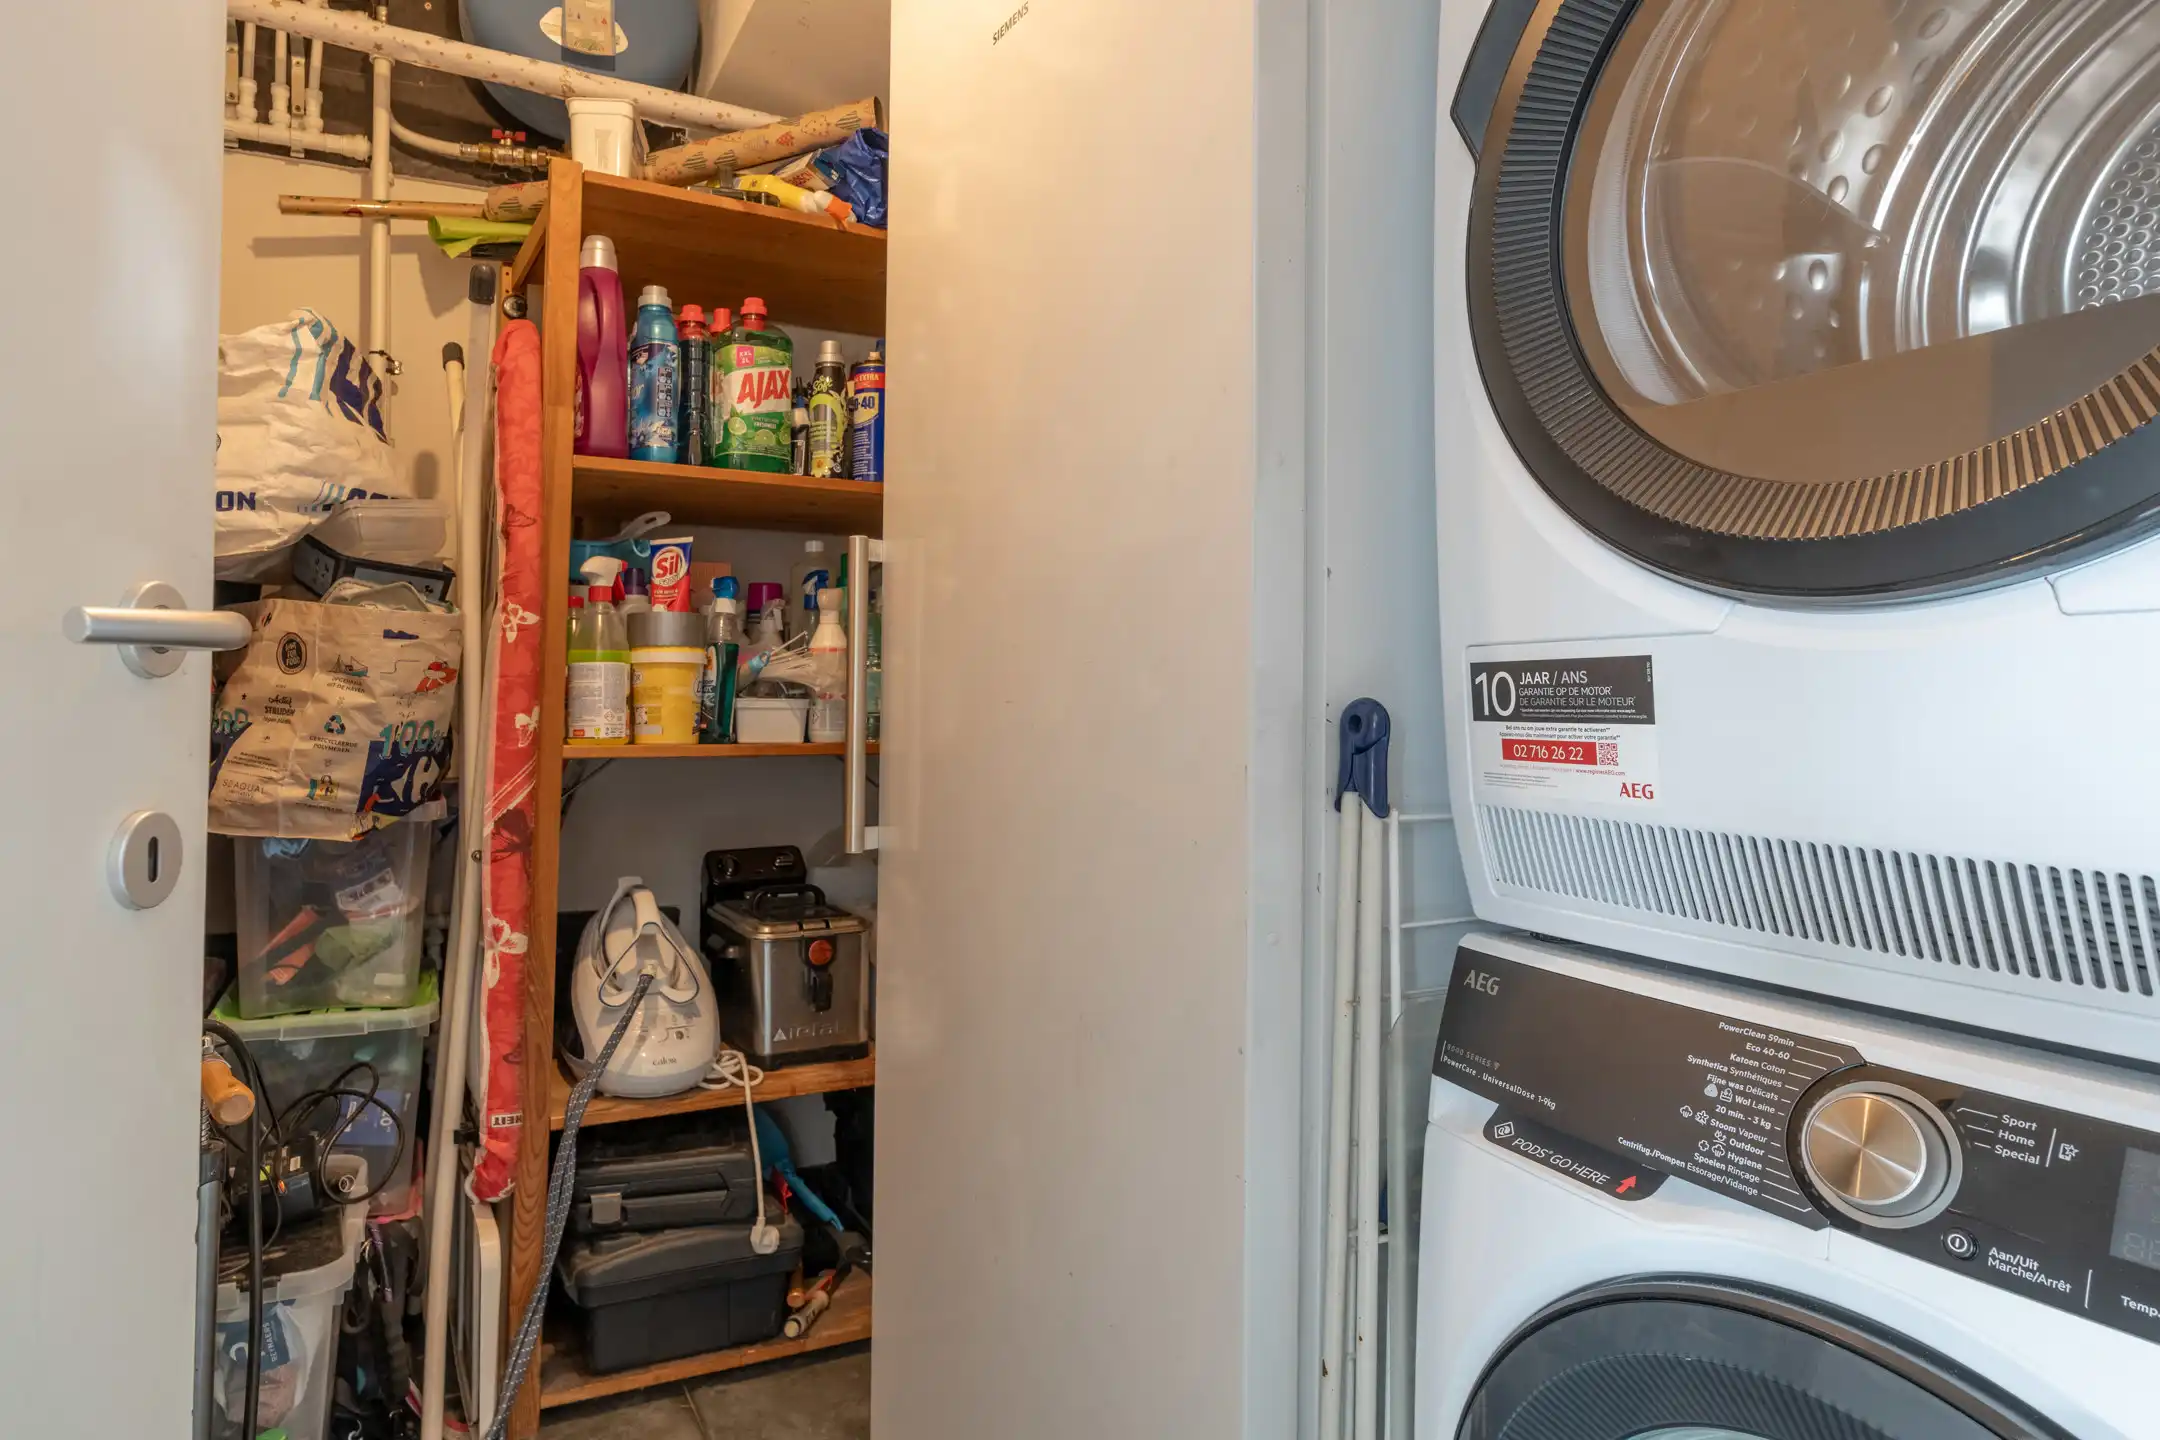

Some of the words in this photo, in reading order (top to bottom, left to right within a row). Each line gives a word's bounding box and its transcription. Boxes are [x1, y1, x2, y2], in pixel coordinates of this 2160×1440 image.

[992, 1, 1029, 46] SIEMENS
[736, 369, 791, 409] AJAX
[655, 553, 680, 579] Sil
[1519, 671, 1551, 685] JAAR
[1552, 670, 1559, 686] /
[1560, 670, 1588, 684] ANS
[1475, 671, 1516, 717] 10
[1518, 687, 1555, 696] GARANTIE
[1555, 687, 1567, 696] OP
[1568, 687, 1580, 696] DE
[1519, 697, 1529, 706] DE
[1530, 697, 1567, 706] GARANTIE
[1568, 697, 1585, 706] SUR
[1586, 696, 1596, 706] LE
[1513, 744, 1528, 758] 02
[1529, 745, 1548, 759] 716
[1551, 746, 1566, 760] 26
[1568, 746, 1584, 761] 22
[1620, 782, 1654, 800] AEG
[1464, 969, 1501, 996] AEG
[1718, 1021, 1767, 1040] PowerClean
[1767, 1033, 1795, 1047] 59min
[1465, 1051, 1491, 1067] SERIES
[1729, 1053, 1760, 1067] Katoen
[1761, 1061, 1786, 1075] Coton
[1745, 1042, 1761, 1053] Eco
[1762, 1047, 1790, 1061] 40-60
[1442, 1055, 1477, 1076] PowerCare
[1482, 1072, 1535, 1101] UniversalDose
[1538, 1095, 1556, 1110] 1-9kg
[1687, 1054, 1729, 1073] Synthetica
[1729, 1066, 1782, 1088] Synthétiques
[1706, 1073, 1727, 1087] Fijne
[1728, 1081, 1744, 1091] was
[1745, 1084, 1779, 1101] Délicats
[1735, 1094, 1751, 1106] Wol
[1752, 1100, 1776, 1114] Laine
[1715, 1104, 1727, 1114] 20
[1728, 1108, 1746, 1121] min.
[1752, 1116, 1759, 1125] 3
[1760, 1118, 1772, 1130] kg
[2001, 1114, 2038, 1131] Sport
[1710, 1118, 1737, 1133] Stoom
[1738, 1127, 1768, 1143] Vapeur
[1998, 1129, 2036, 1147] Home
[1729, 1138, 1766, 1156] Outdoor
[1994, 1144, 2040, 1165] Special
[1549, 1154, 1572, 1168] GO
[1569, 1163, 1611, 1185] HERE
[1617, 1136, 1686, 1168] Centrifug./Pompen
[1686, 1162, 1759, 1196] Essorage/Vidange
[1693, 1152, 1726, 1171] Spoelen
[1727, 1164, 1760, 1183] Rinçage
[1988, 1246, 2040, 1271] Aan/Uit
[1987, 1257, 2073, 1293] Marche/Arrêt
[262, 1322, 278, 1362] REYNAERS
